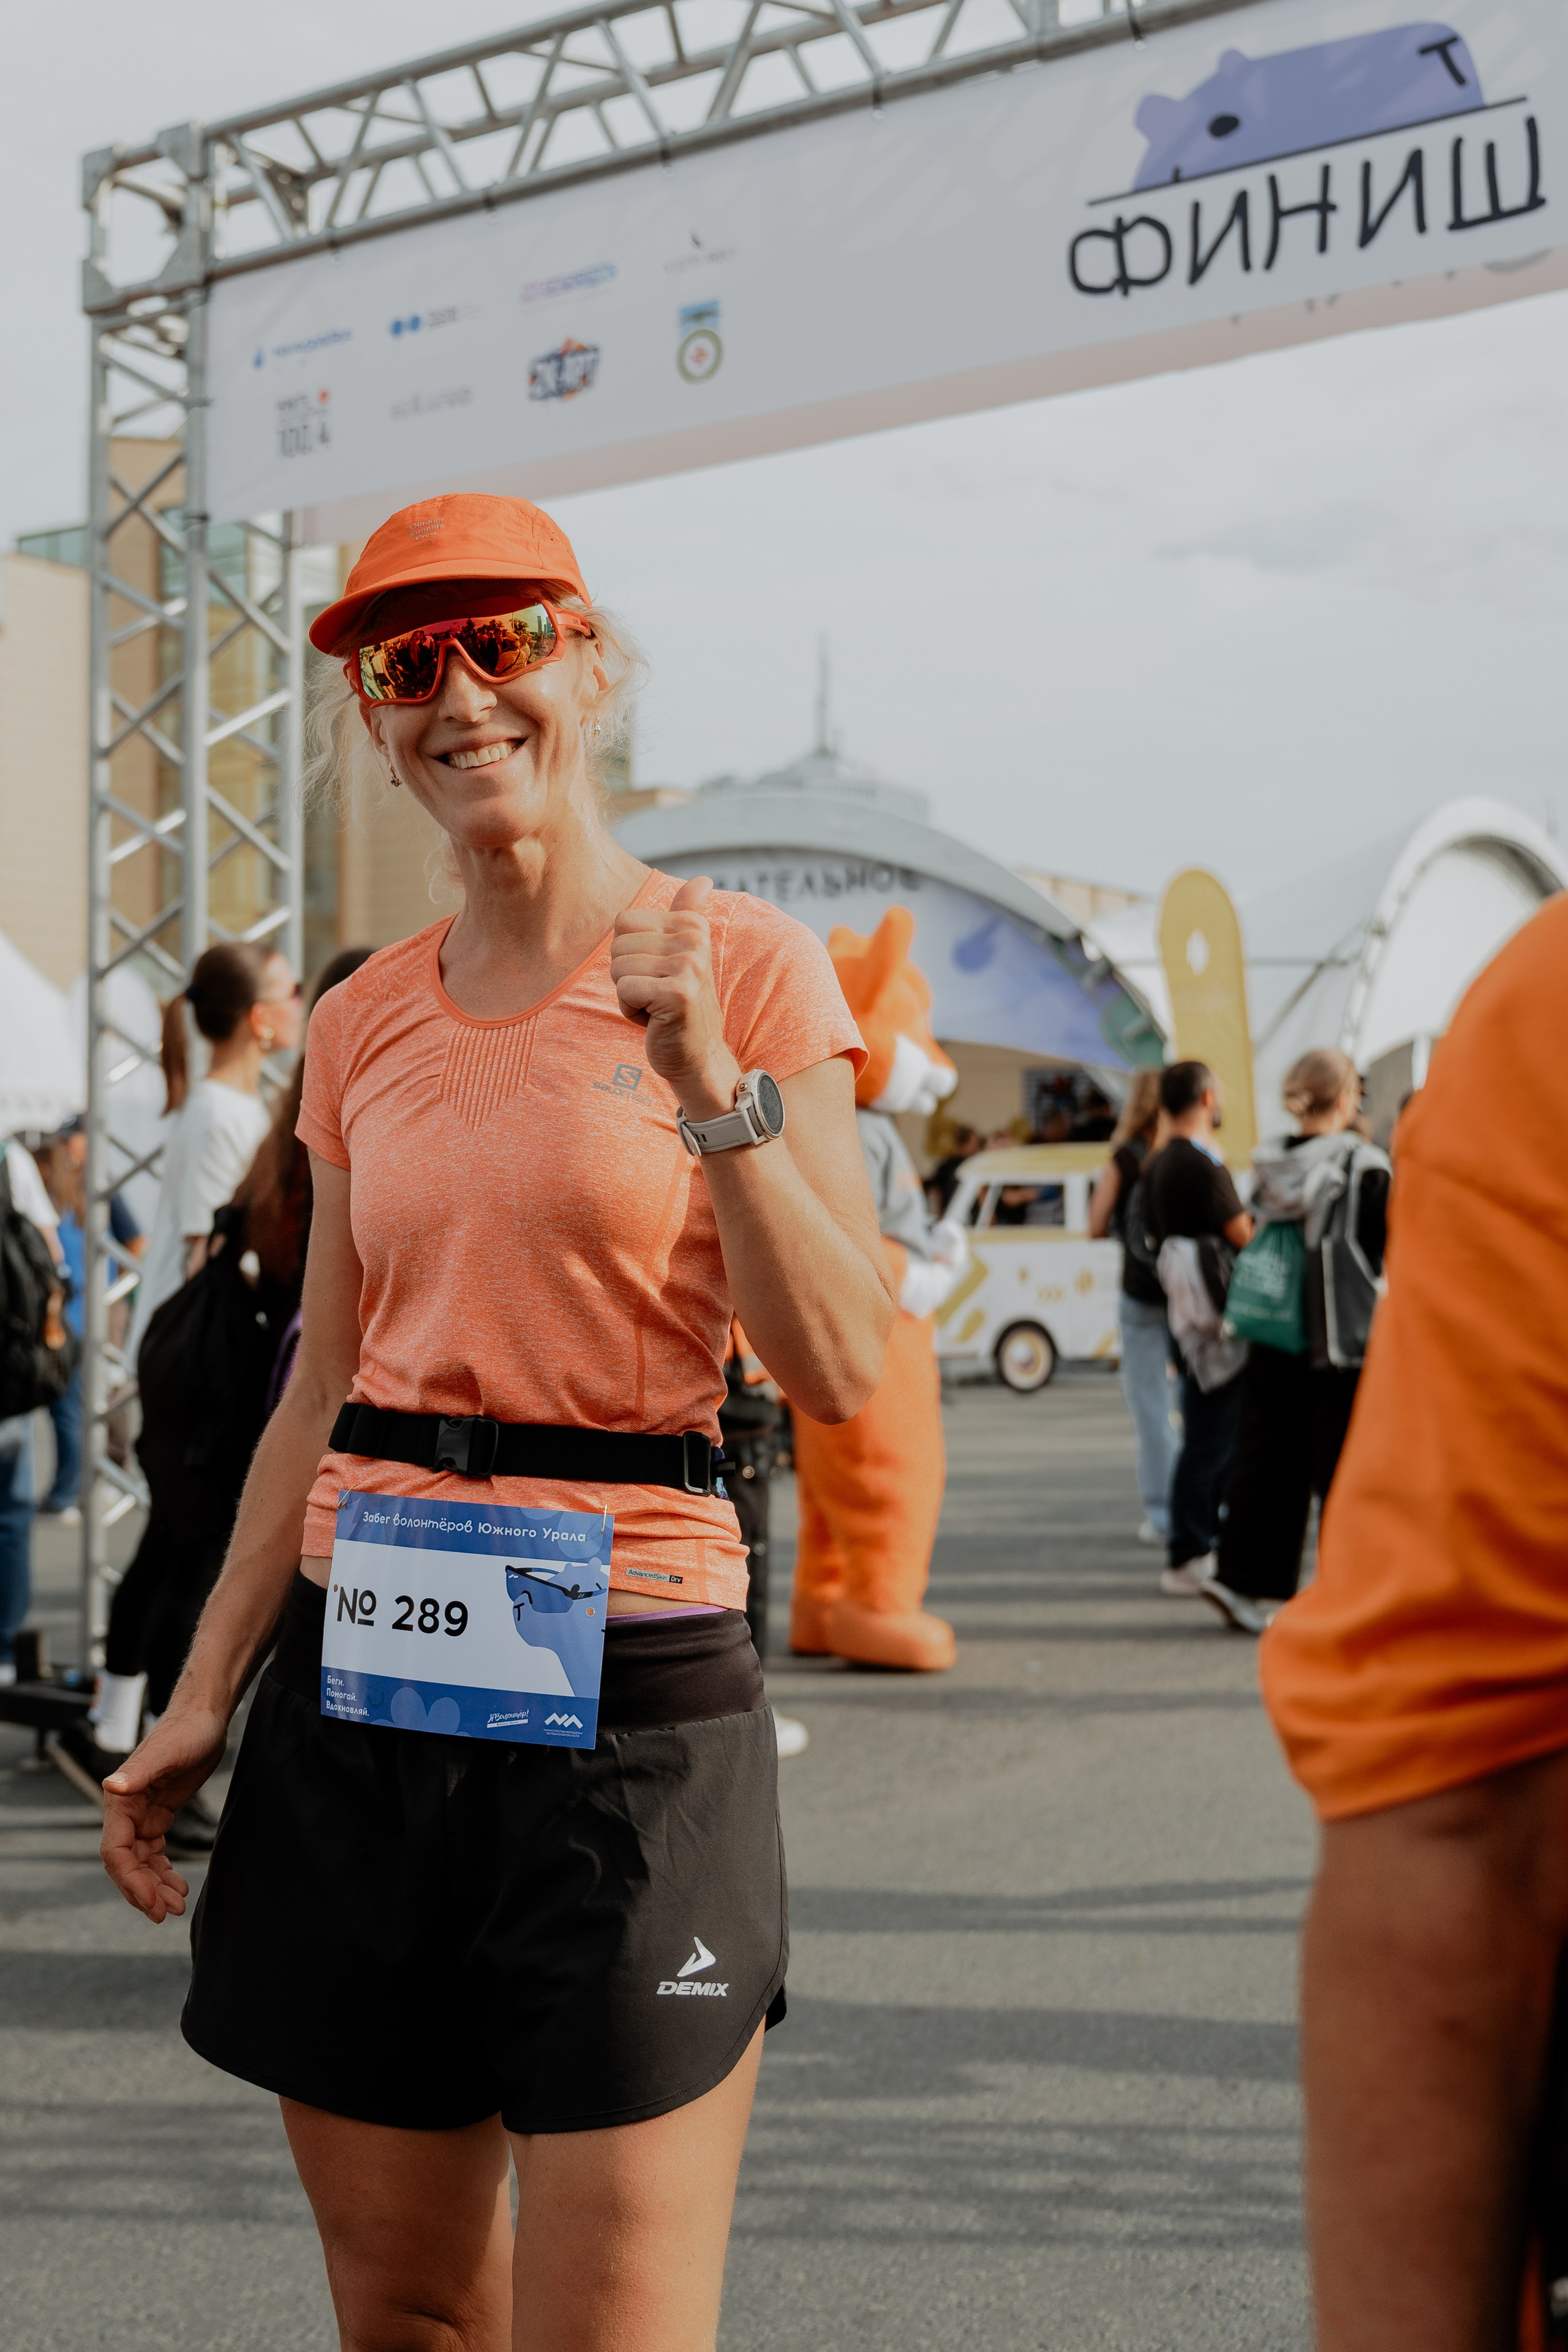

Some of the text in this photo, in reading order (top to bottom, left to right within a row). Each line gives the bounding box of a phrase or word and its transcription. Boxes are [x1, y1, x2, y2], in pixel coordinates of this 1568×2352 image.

[1069, 115, 1546, 296] ФИНИШ
[409, 518, 443, 530] Outdoor
[410, 524, 444, 537] Running
[415, 532, 437, 541] Crew
[363, 1511, 586, 1543] Забег волонтёров Южного Урала
[628, 1569, 667, 1580] AdvancedSkin
[392, 1595, 469, 1637] 289
[327, 1675, 344, 1686] Беги.
[326, 1687, 358, 1702] Помогай.
[326, 1700, 369, 1716] Вдохновляй.
[656, 1981, 729, 1997] DEMIX
